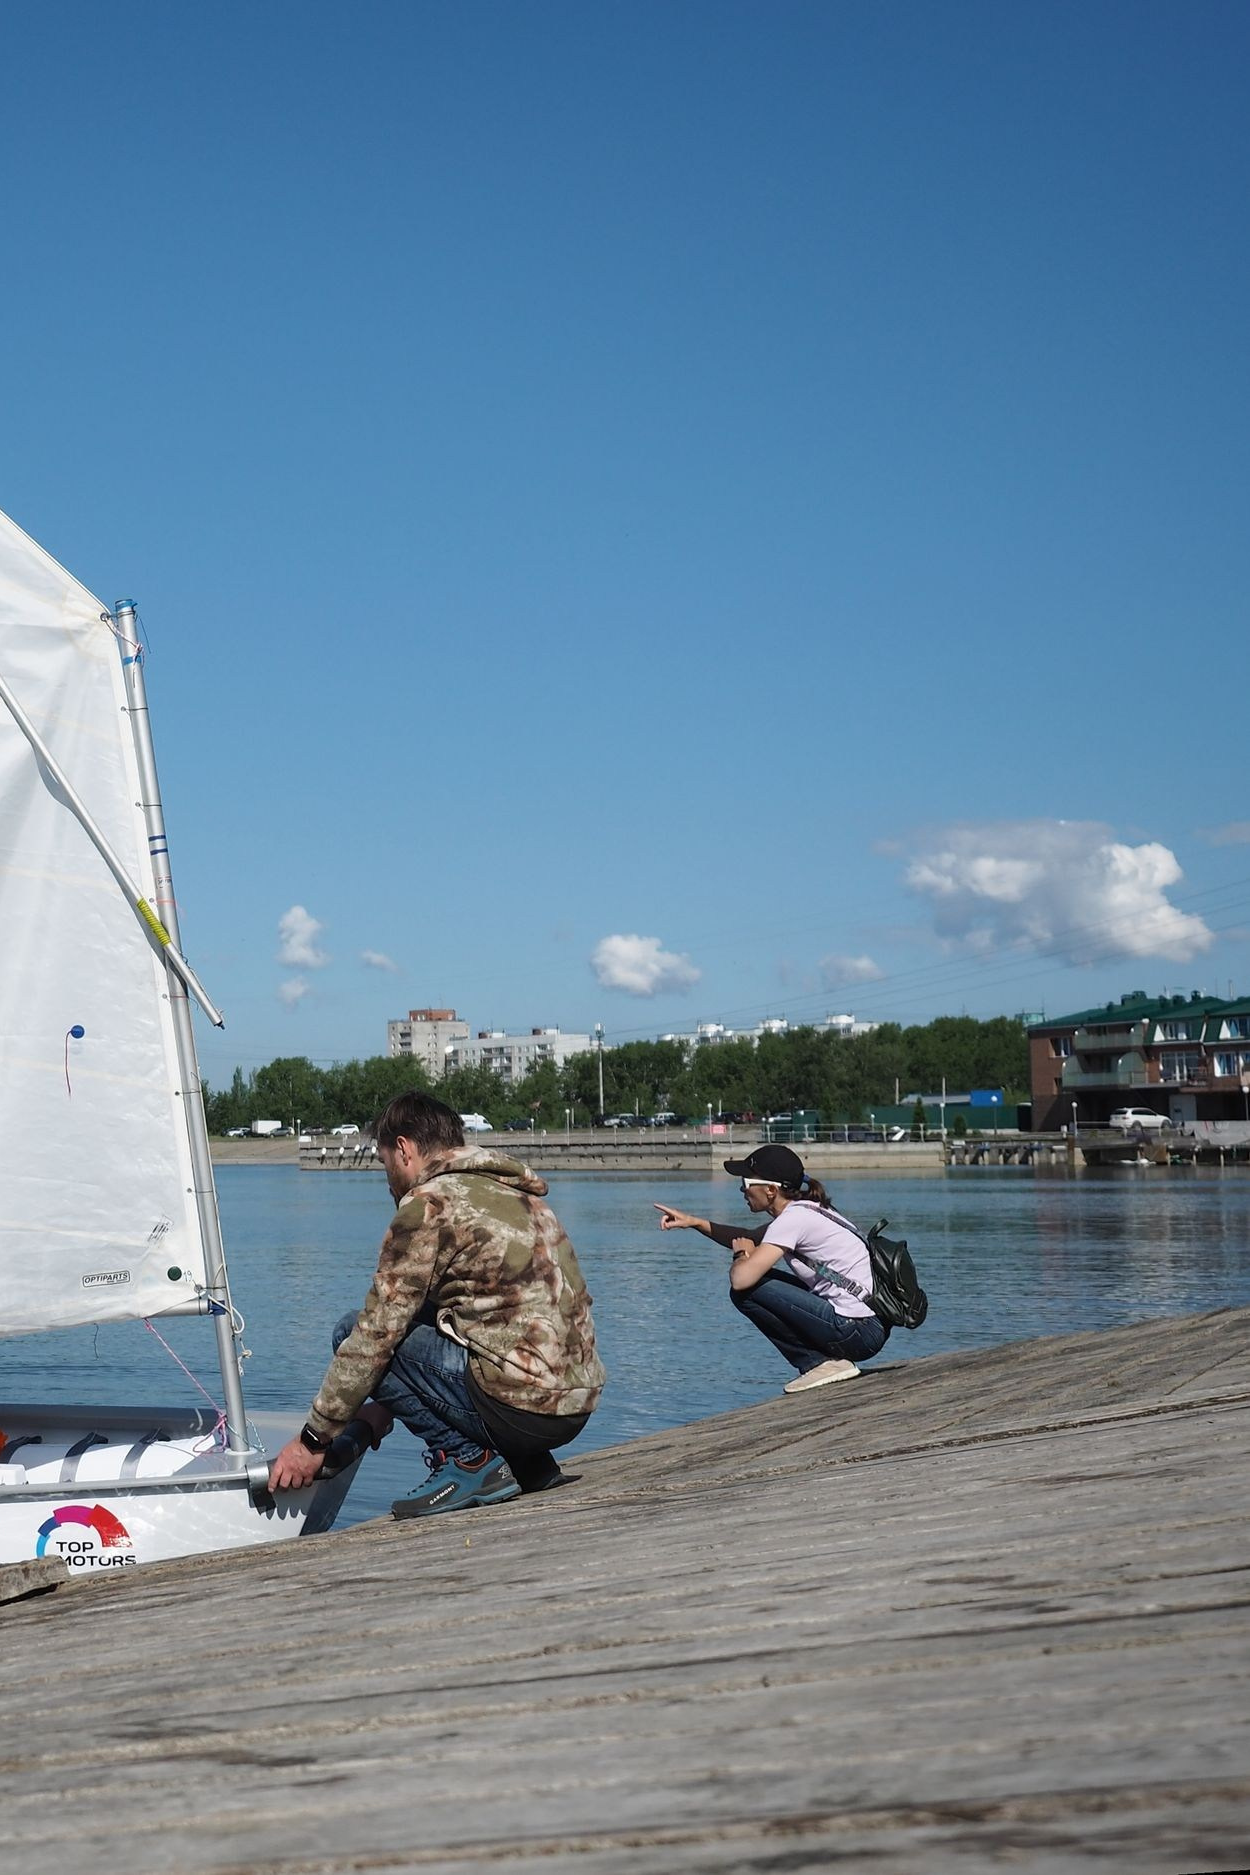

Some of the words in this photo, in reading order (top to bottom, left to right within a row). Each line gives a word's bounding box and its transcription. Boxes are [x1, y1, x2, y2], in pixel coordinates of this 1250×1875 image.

[84, 1272, 128, 1284] OPTIPARTS
[430, 1484, 455, 1505] GARMONT
[56, 1541, 93, 1553] TOP
